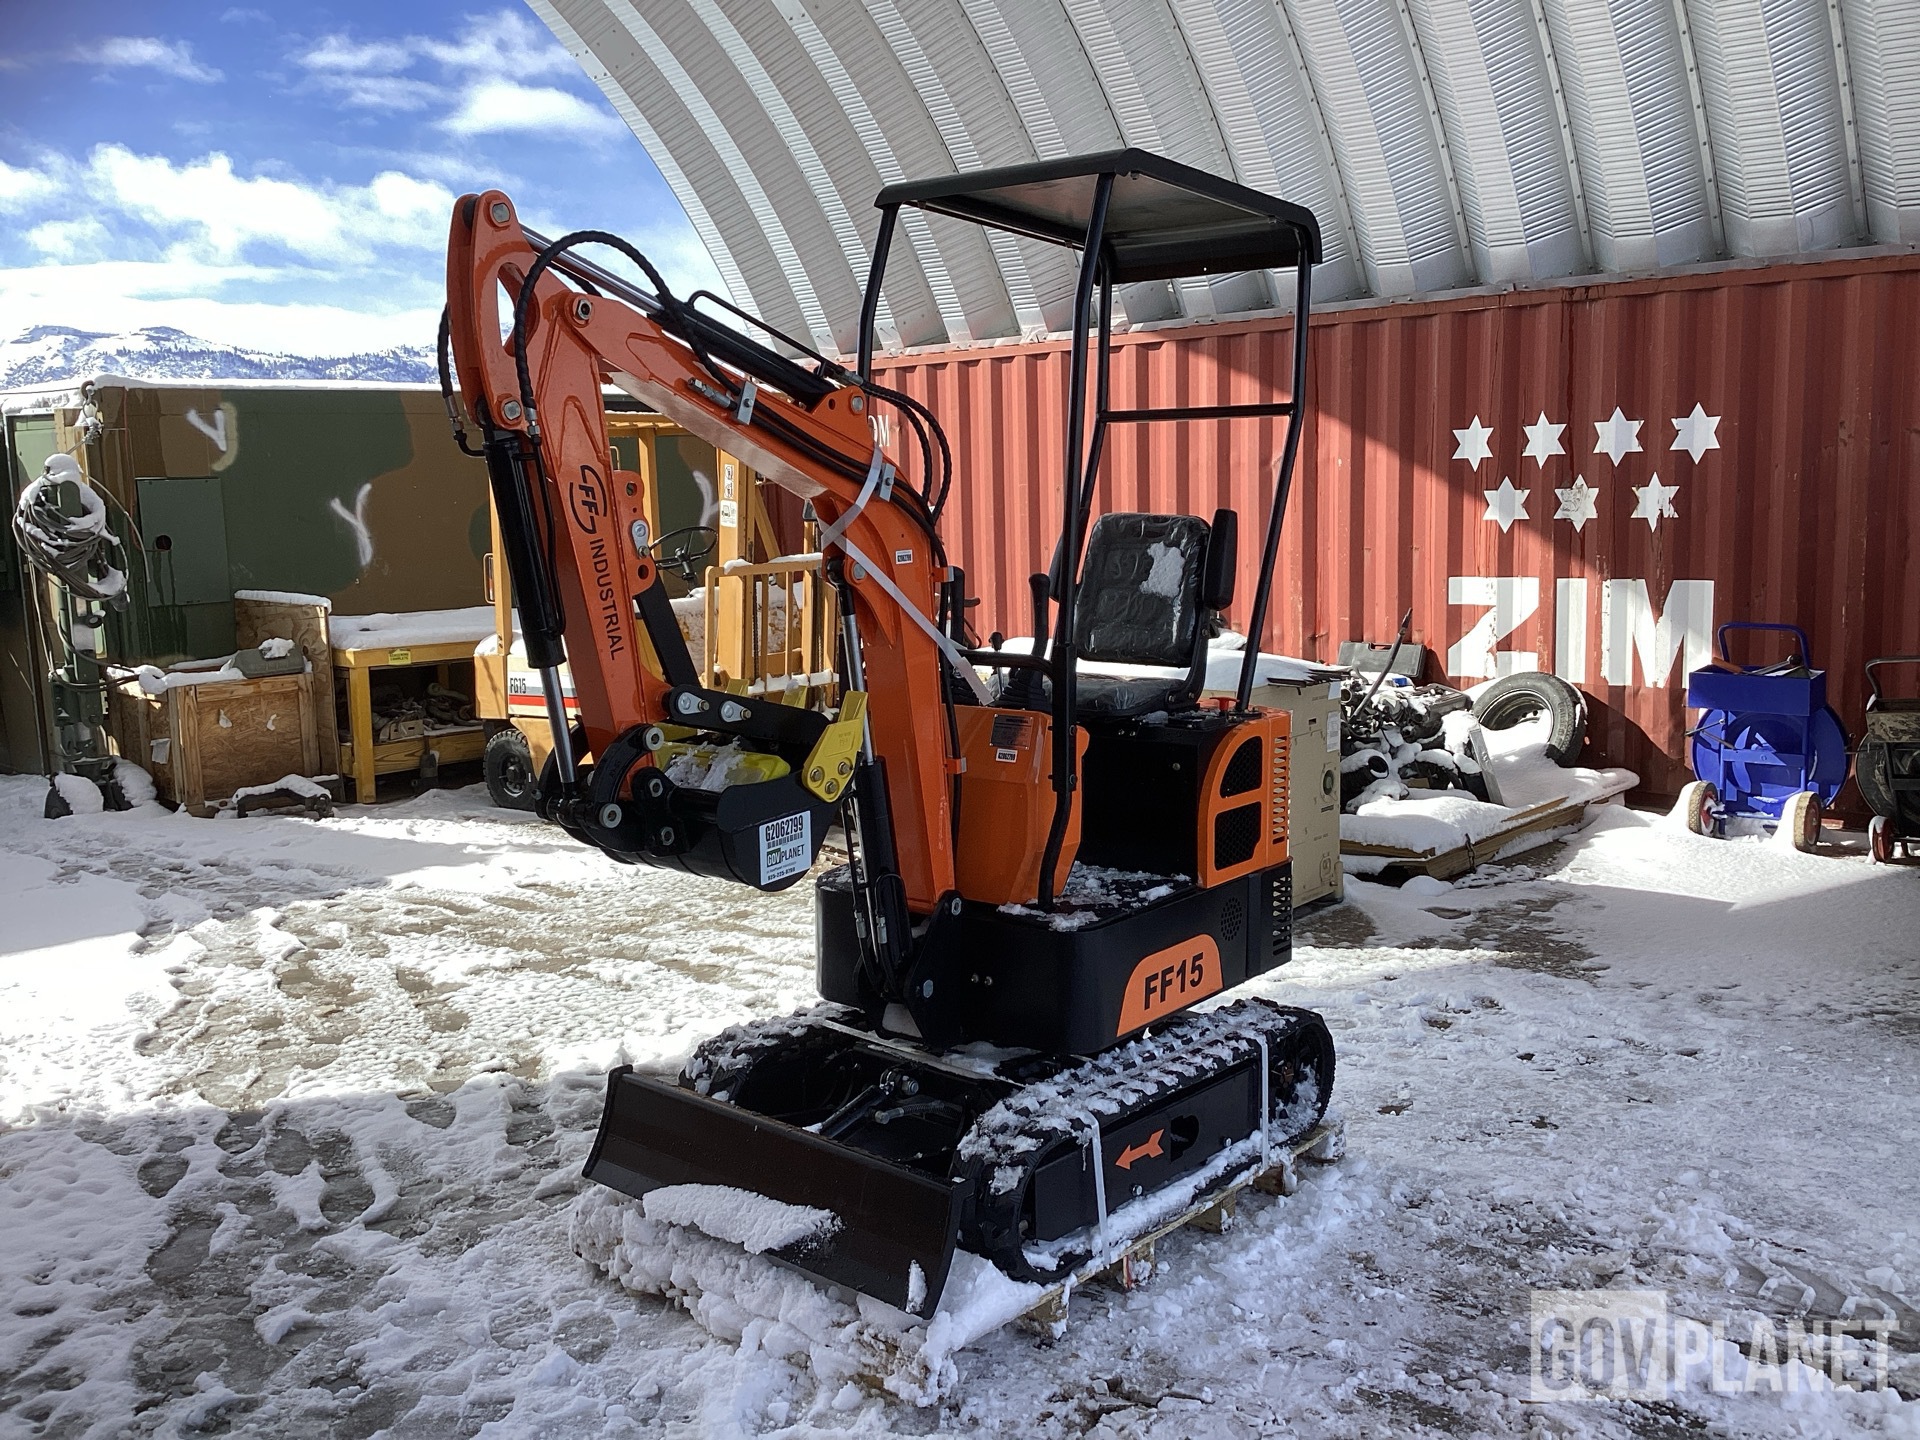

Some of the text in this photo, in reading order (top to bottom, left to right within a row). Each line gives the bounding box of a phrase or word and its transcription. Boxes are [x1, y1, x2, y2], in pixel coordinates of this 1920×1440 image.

[589, 538, 625, 661] INDUSTRIAL
[1447, 576, 1715, 690] ZIM
[509, 678, 527, 694] FG15
[765, 815, 804, 842] G2062799
[1144, 951, 1204, 1011] FF15
